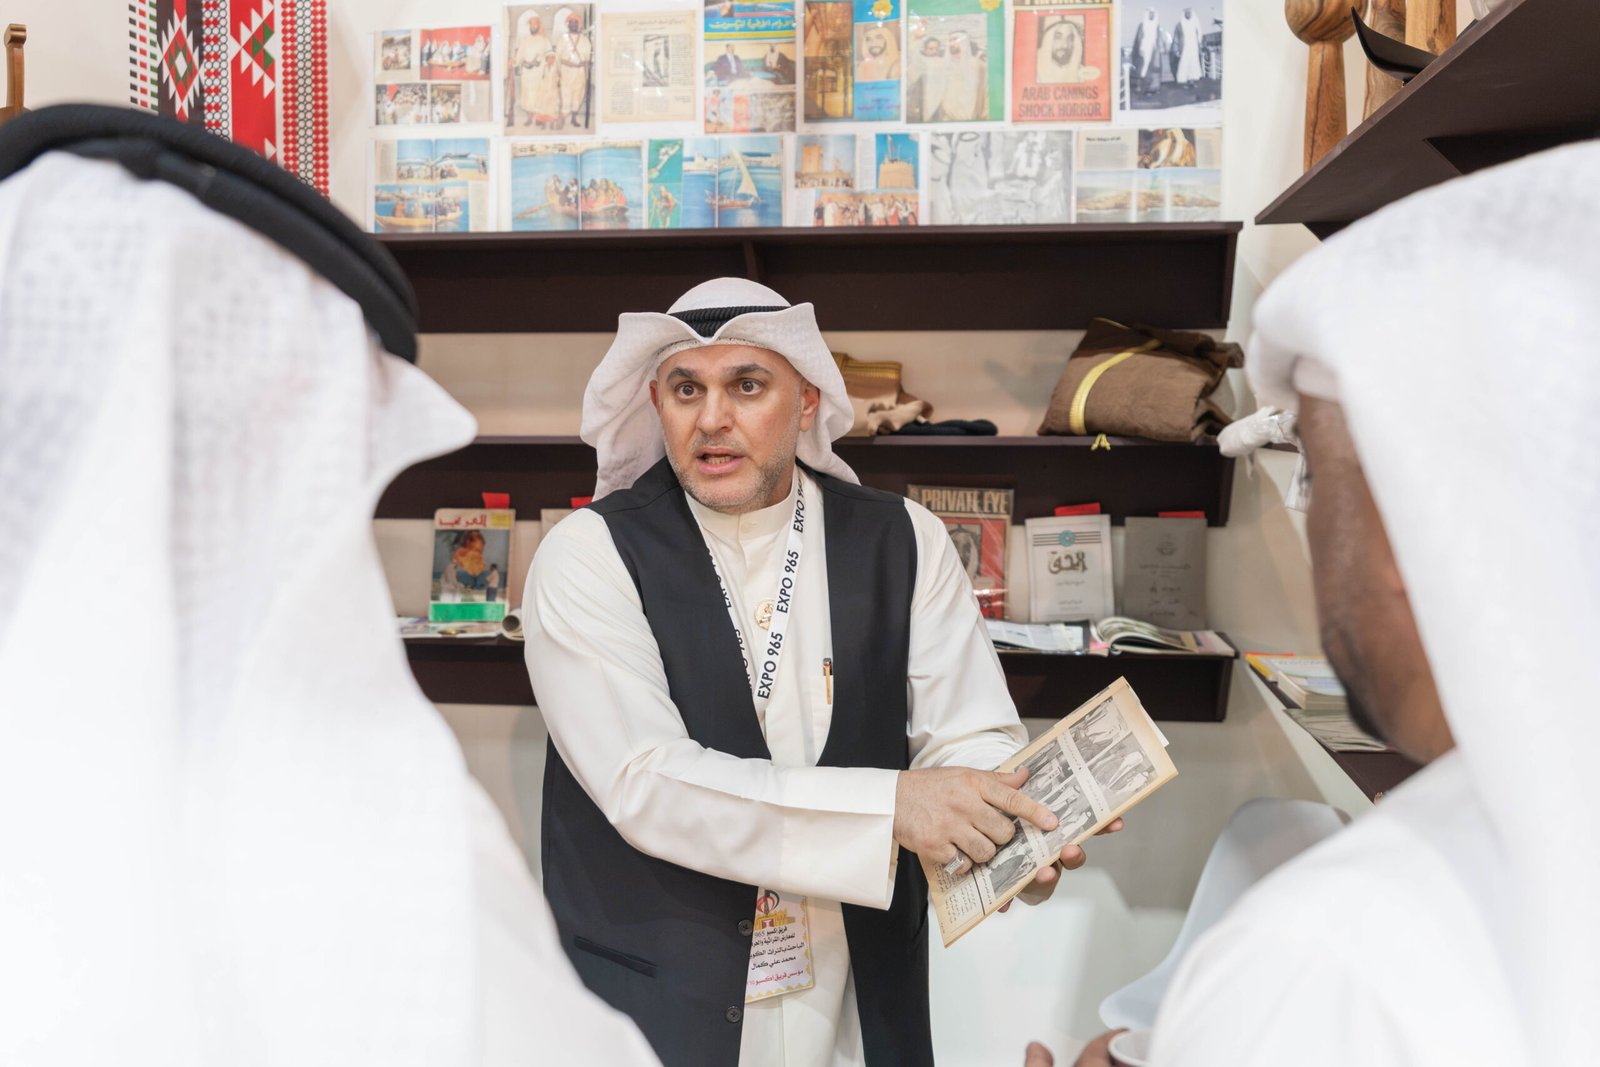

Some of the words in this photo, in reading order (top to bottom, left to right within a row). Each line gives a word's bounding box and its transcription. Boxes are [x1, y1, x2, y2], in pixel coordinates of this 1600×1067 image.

[1022, 86, 1051, 101] ARAB
[1018, 103, 1055, 118] SHOCK
[1057, 102, 1102, 117] HORROR
[921, 488, 981, 512] PRIVATE
[983, 490, 1009, 514] EYE
[793, 499, 805, 533] EXPO
[776, 577, 793, 614] EXPO
[785, 550, 800, 574] 965
[757, 660, 777, 700] EXPO
[767, 631, 783, 657] 965
[751, 961, 768, 971] كمال
